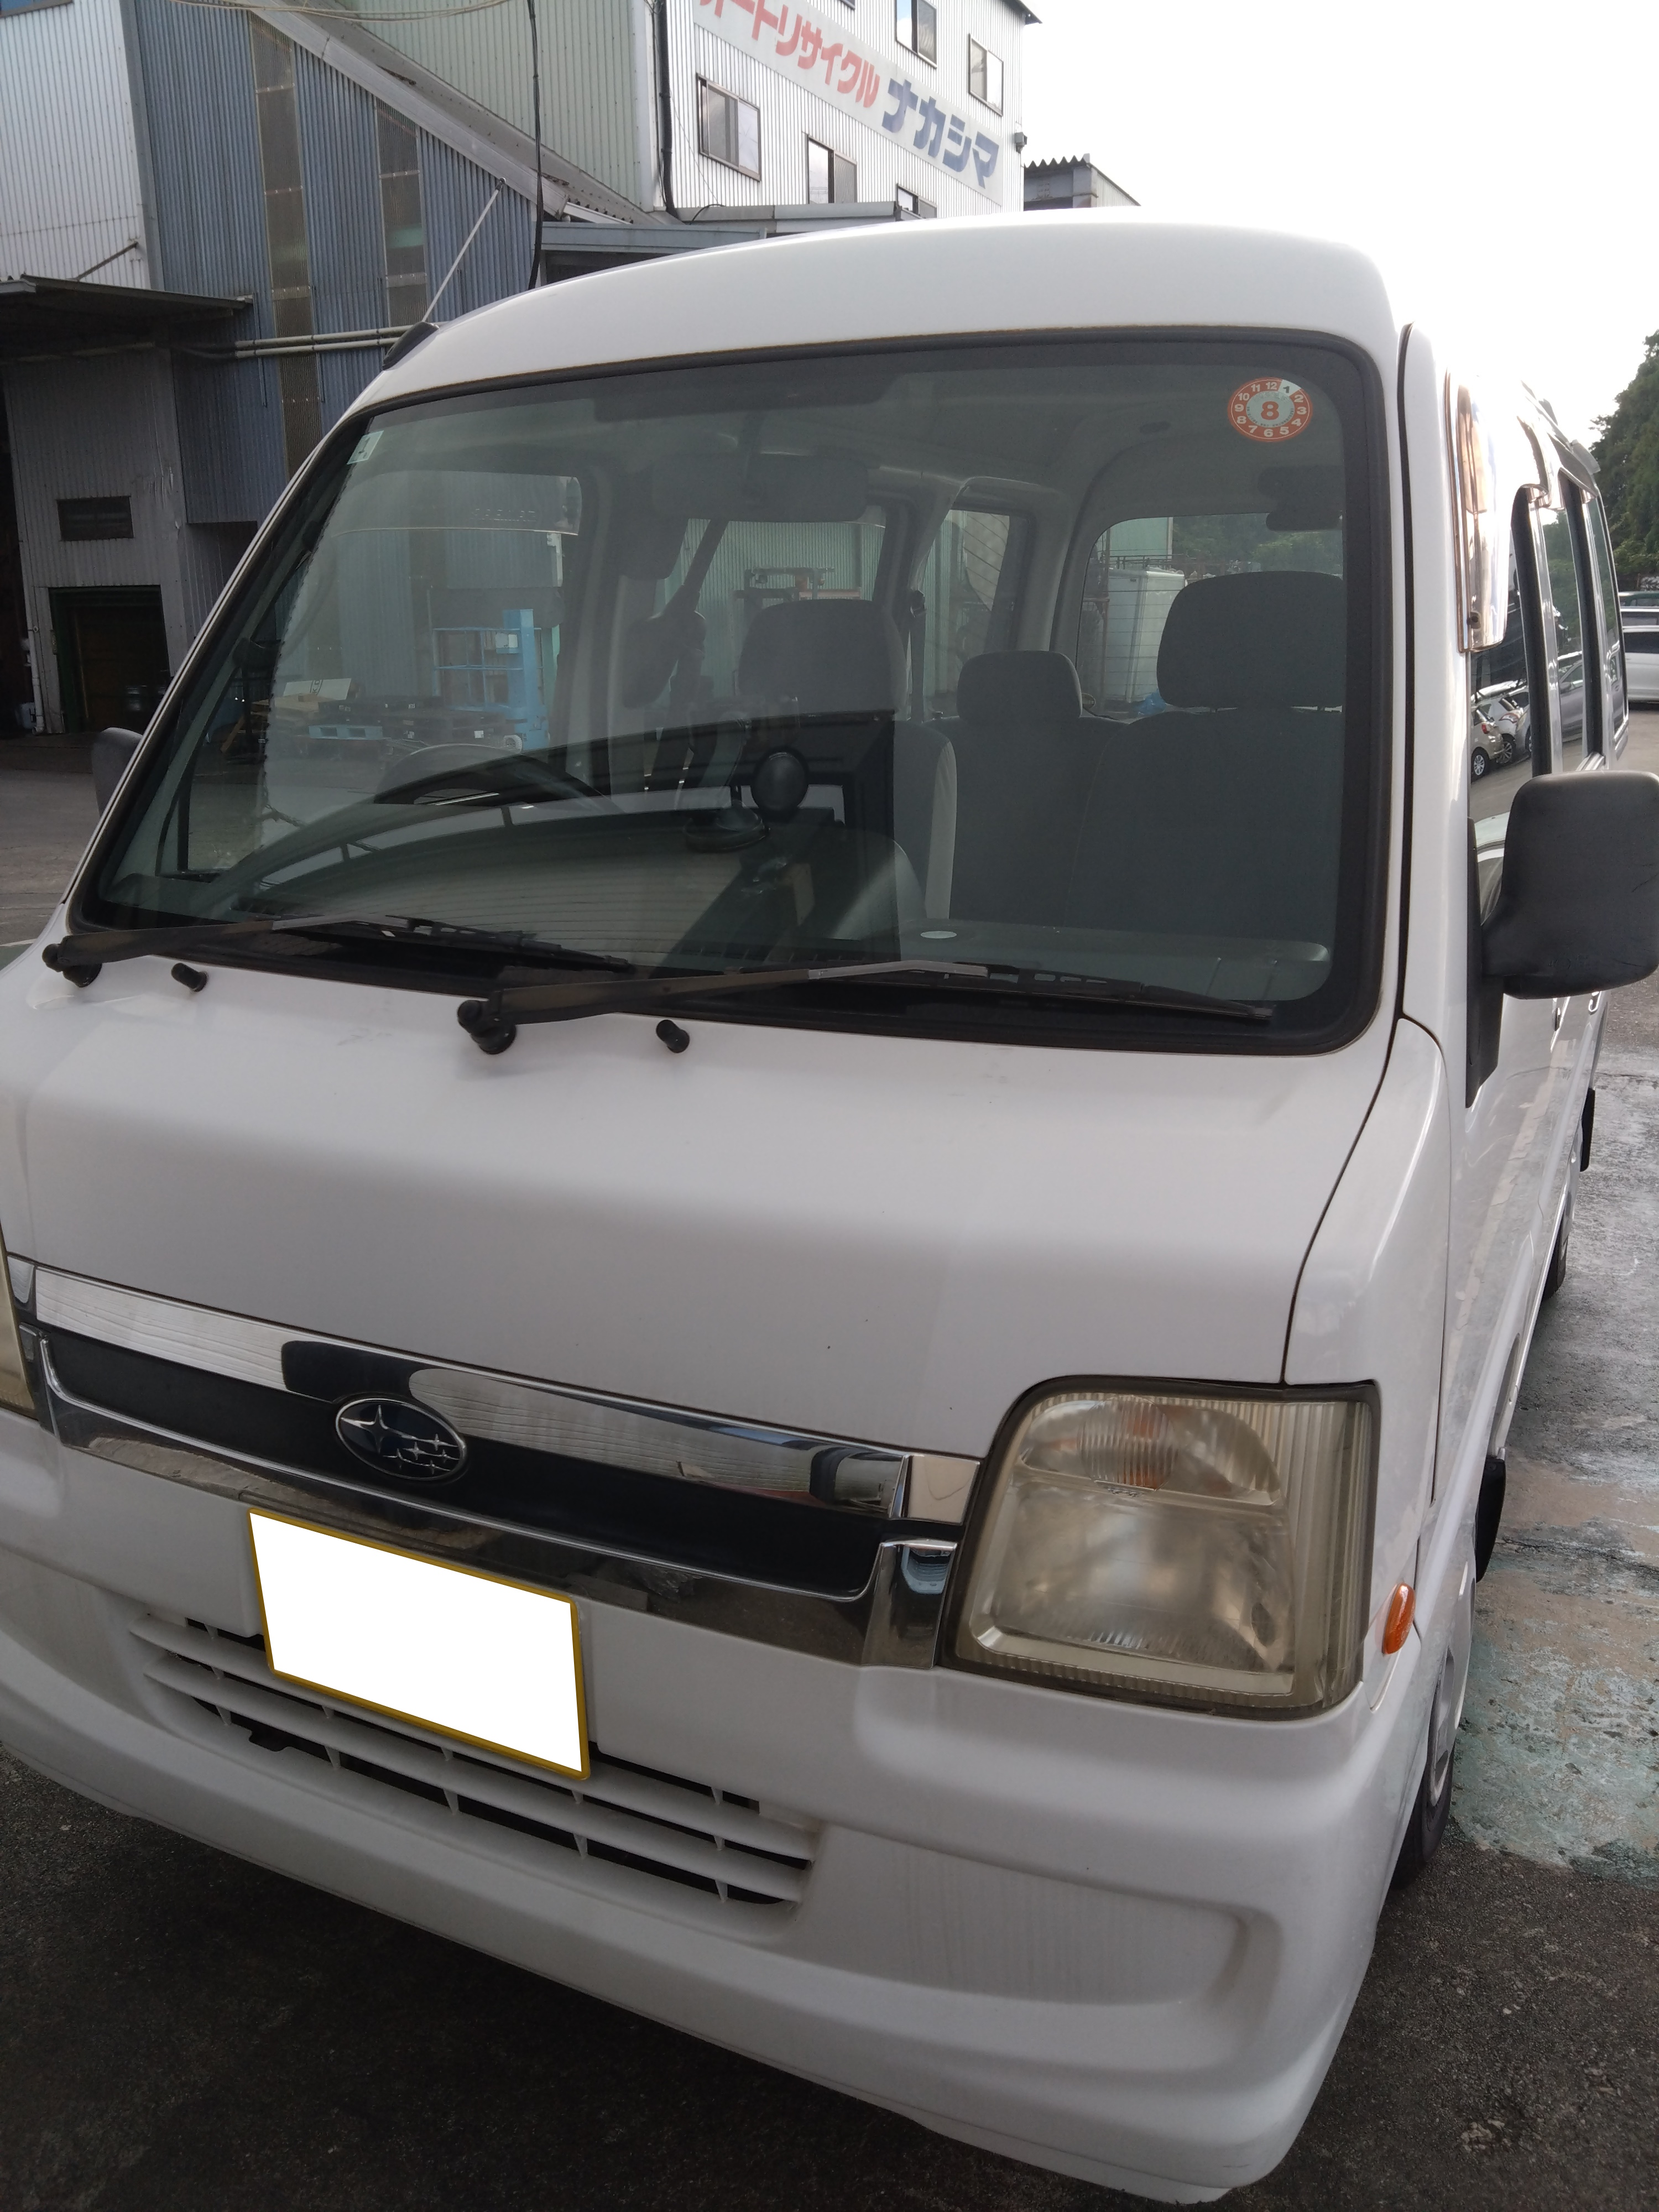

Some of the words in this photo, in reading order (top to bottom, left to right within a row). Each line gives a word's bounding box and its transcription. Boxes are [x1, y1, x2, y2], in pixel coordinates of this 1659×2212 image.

[700, 0, 880, 108] ートリサイクル
[881, 77, 1000, 189] ナカシマ
[1266, 382, 1277, 390] 12
[1294, 394, 1303, 403] 2
[1261, 401, 1279, 420] 8
[1291, 418, 1301, 426] 4
[1264, 429, 1274, 437] 6
[1280, 426, 1289, 435] 5
